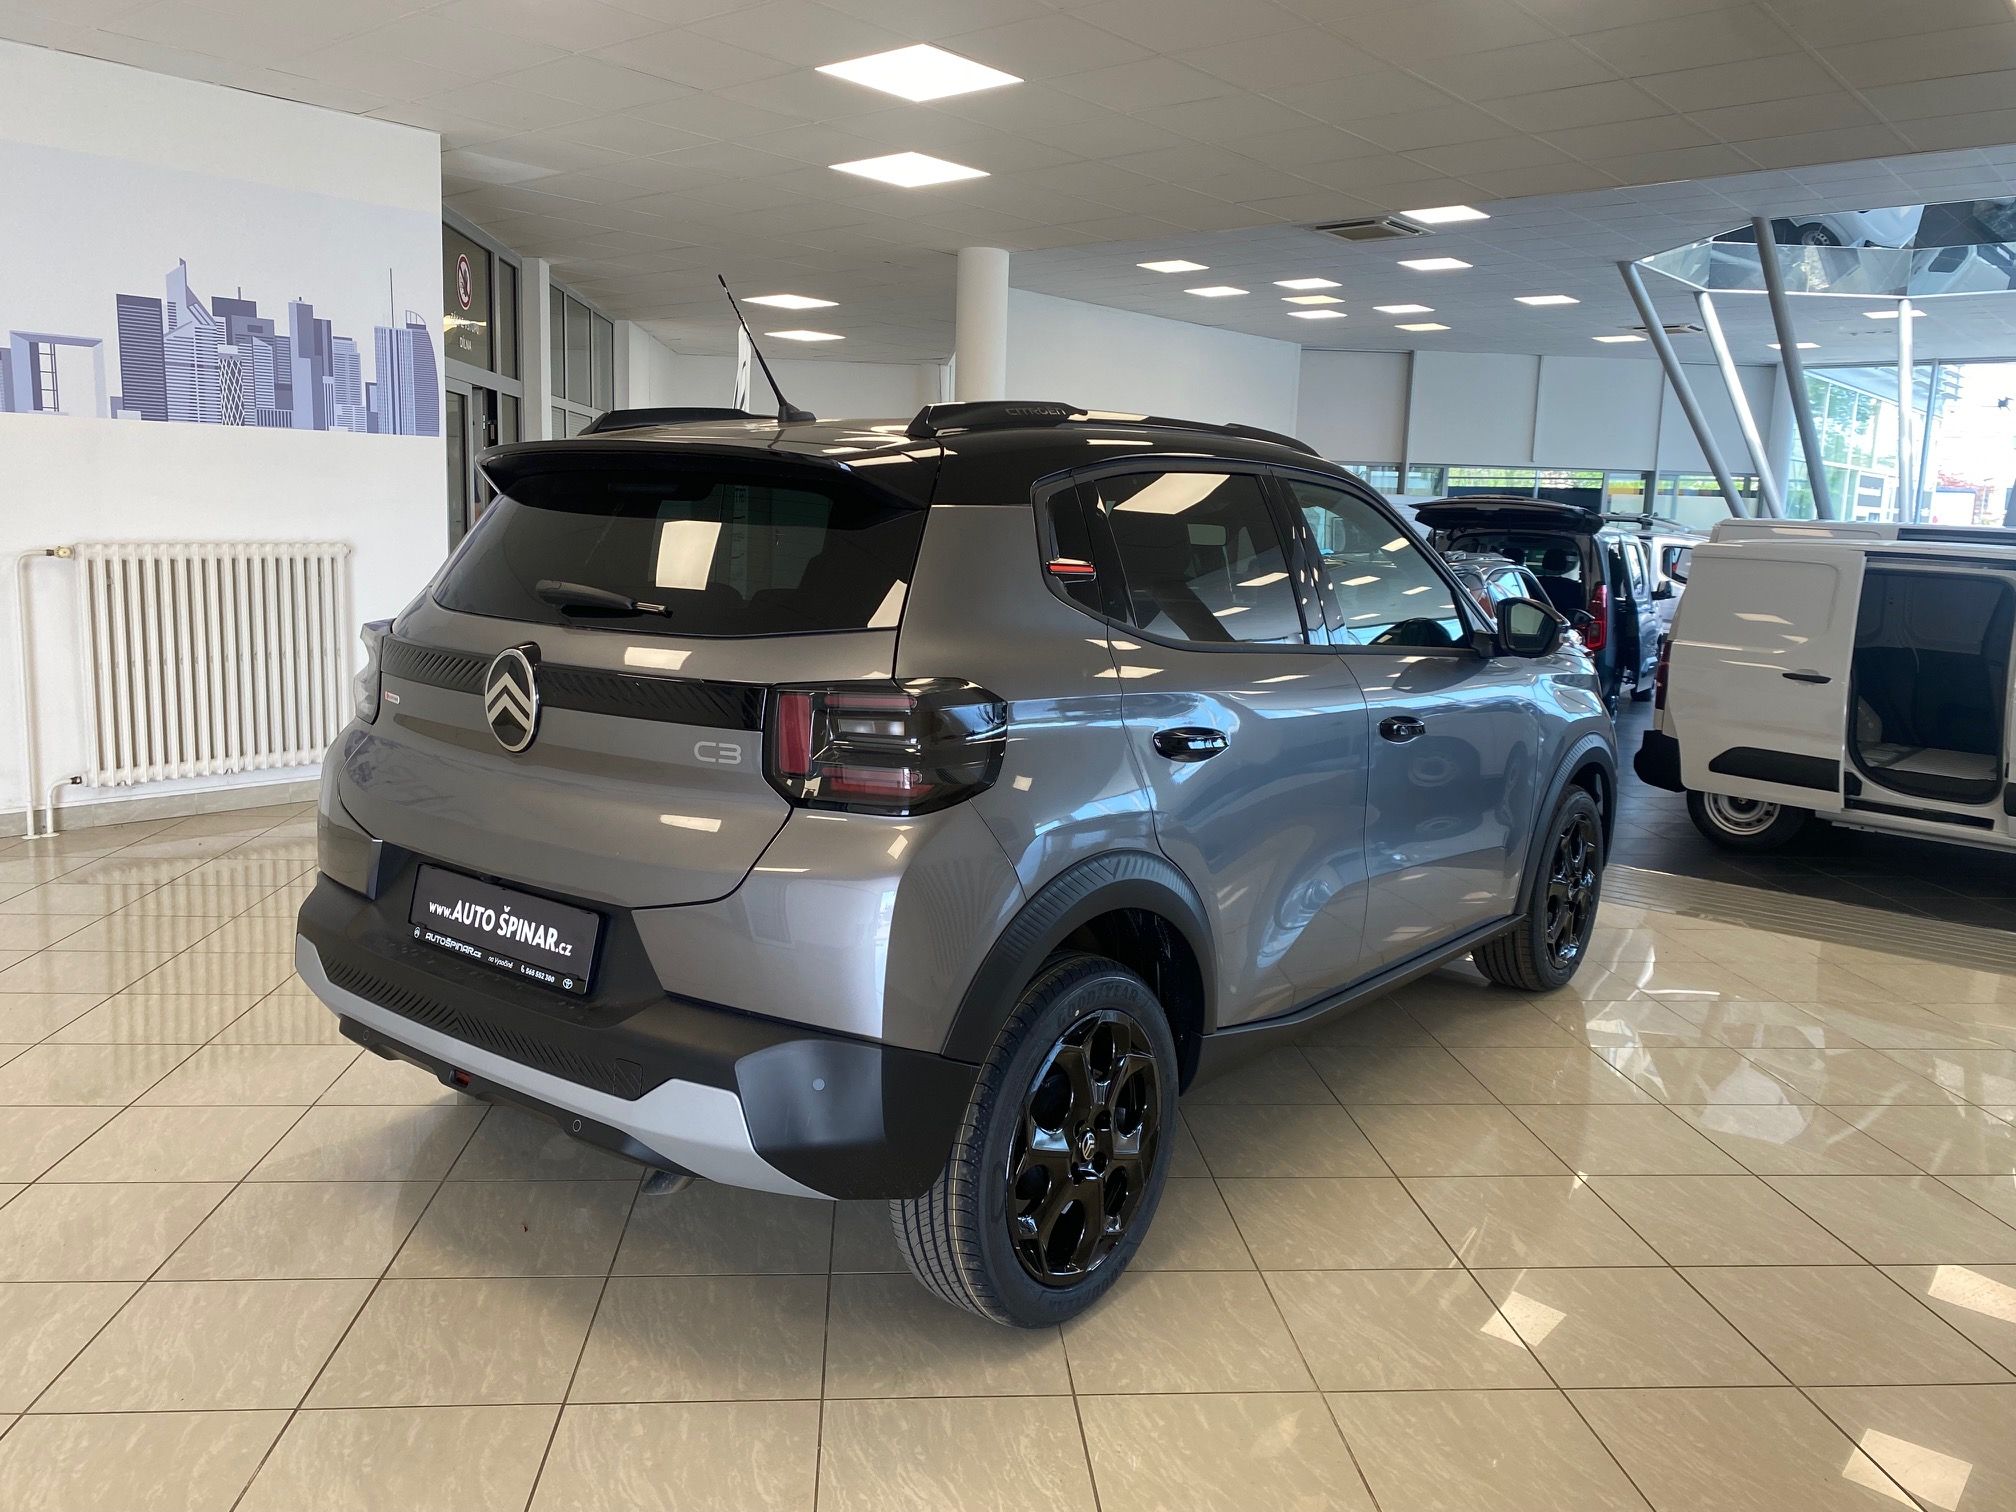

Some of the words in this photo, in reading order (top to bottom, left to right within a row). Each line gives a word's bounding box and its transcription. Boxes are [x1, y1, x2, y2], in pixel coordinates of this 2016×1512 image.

[694, 741, 742, 764] C3
[429, 900, 495, 931] www.AUTO
[497, 905, 572, 956] ŠPINAR.cz
